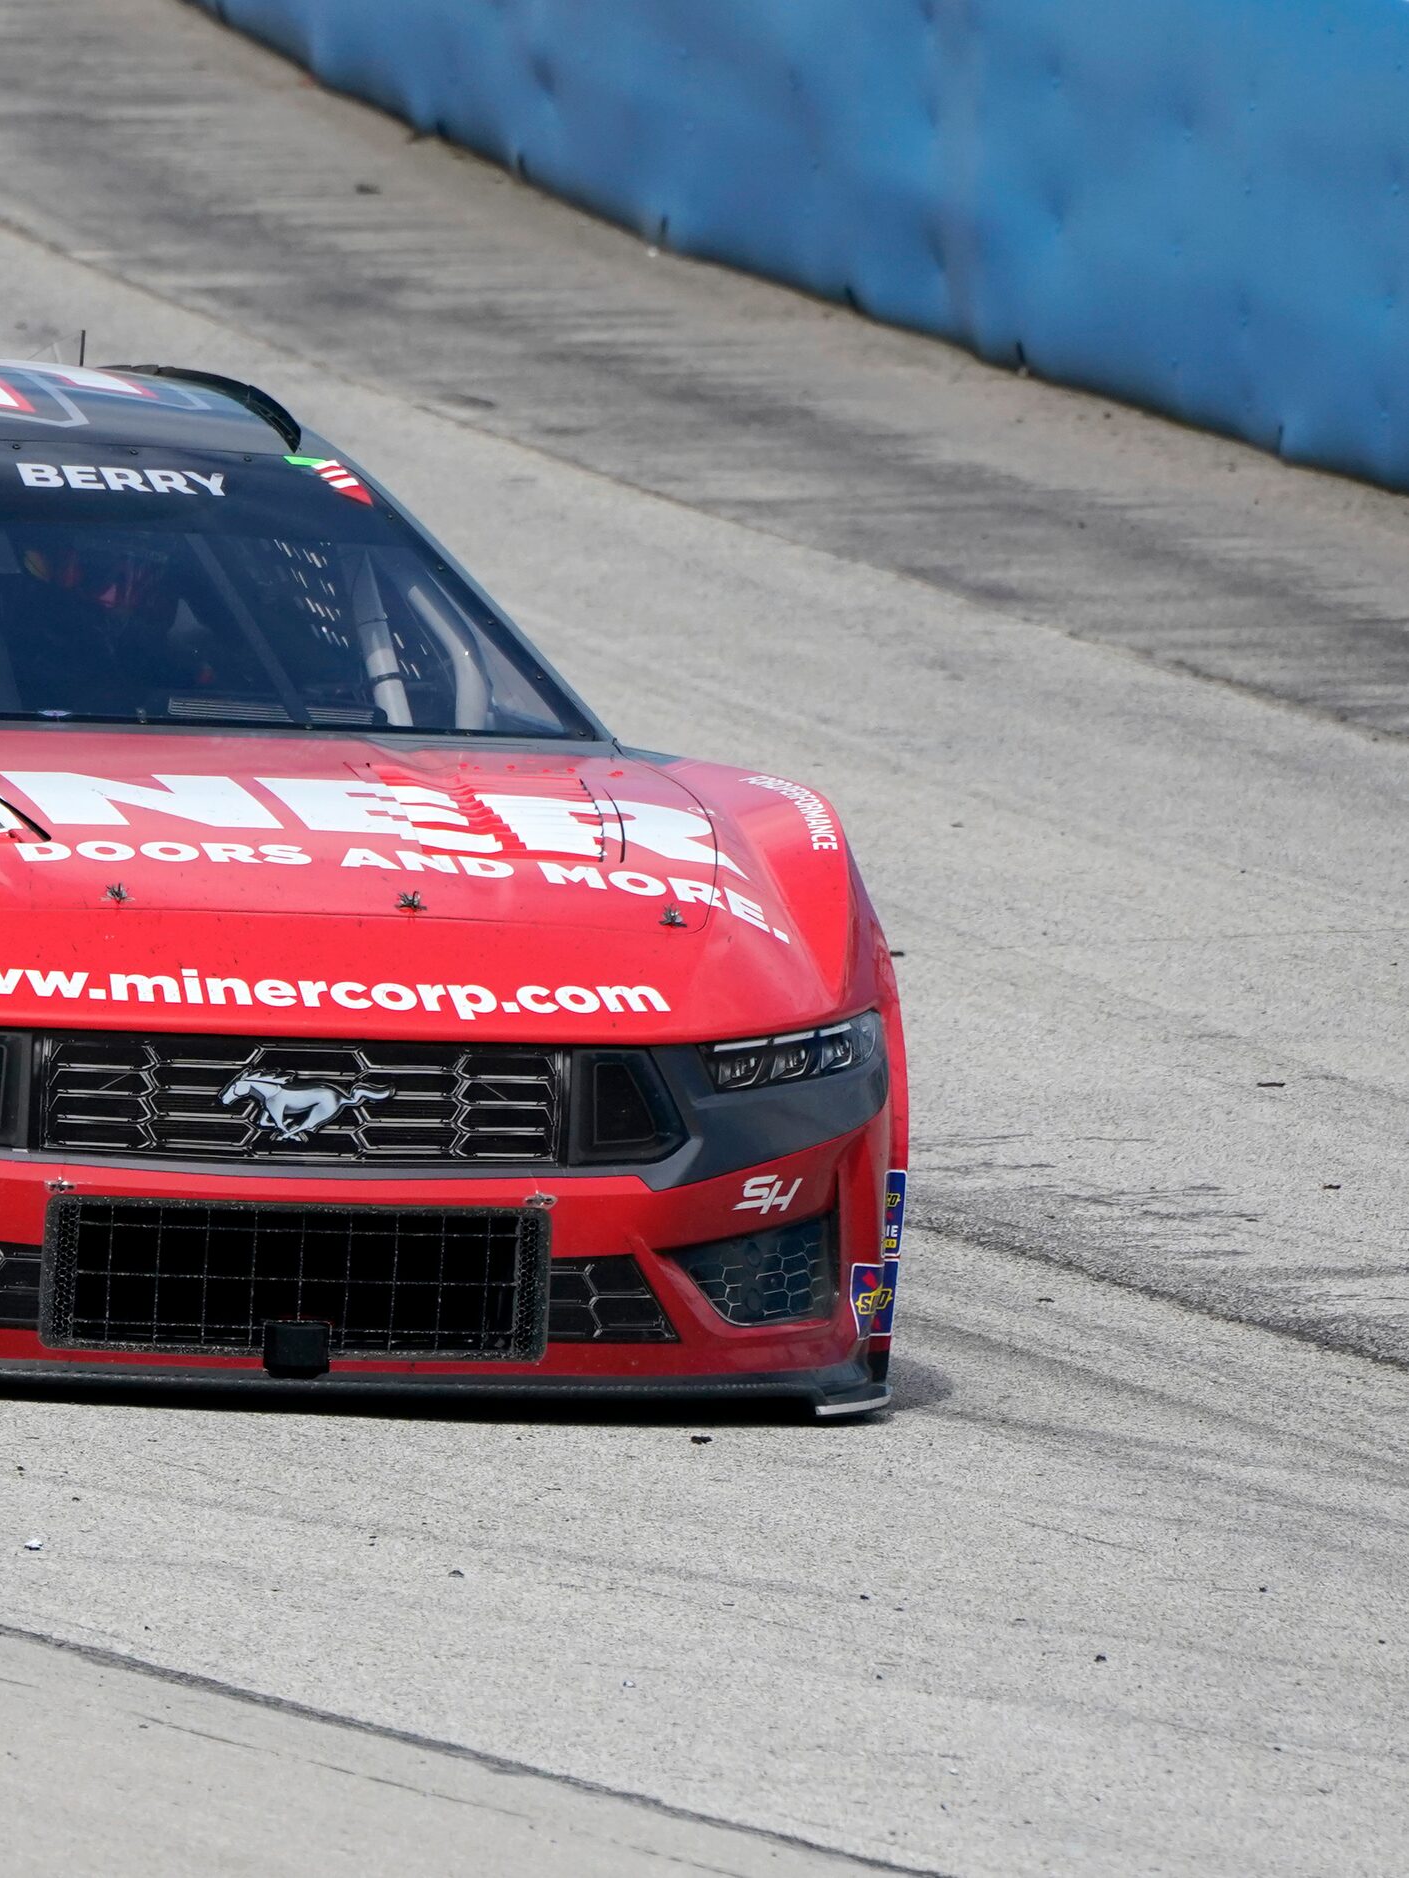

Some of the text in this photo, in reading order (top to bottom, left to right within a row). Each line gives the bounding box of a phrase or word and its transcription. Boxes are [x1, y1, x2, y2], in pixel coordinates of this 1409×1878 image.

[16, 463, 226, 497] BERRY
[774, 781, 838, 850] PERFORMANCE
[16, 841, 312, 865] DOORS
[341, 848, 514, 879] AND
[544, 863, 791, 944] MORE.
